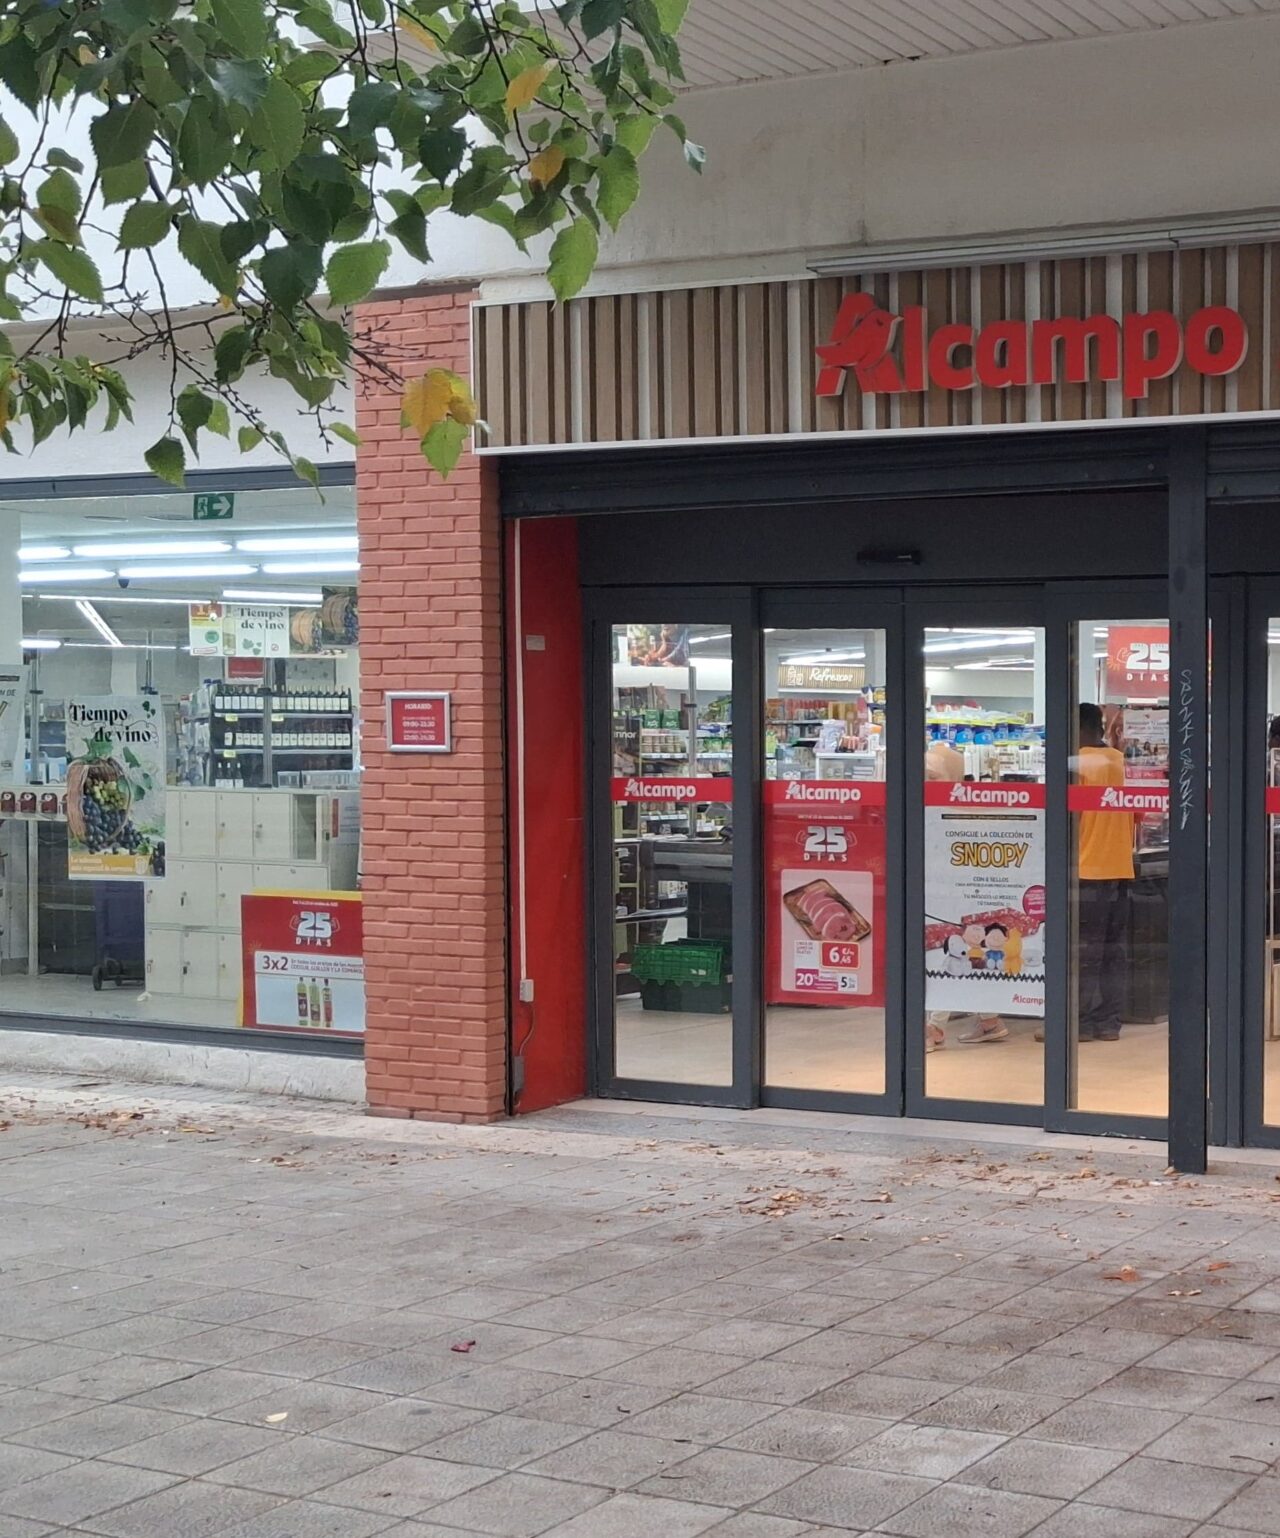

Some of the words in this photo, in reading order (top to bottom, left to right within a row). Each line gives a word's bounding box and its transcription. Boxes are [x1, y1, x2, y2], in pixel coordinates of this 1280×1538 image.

[815, 292, 1248, 399] Alcampo
[238, 607, 285, 620] Tiempo
[241, 620, 254, 629] de
[259, 620, 285, 630] vino
[1126, 643, 1169, 670] 25
[809, 667, 853, 682] Refrescos
[1127, 671, 1169, 682] DÍAS
[69, 704, 128, 723] Tiempo
[94, 728, 112, 743] de
[117, 727, 151, 743] vino
[624, 778, 697, 800] Alcampo
[785, 781, 861, 803] Alcampo
[949, 782, 1030, 806] Alcampo
[804, 826, 849, 853] 25
[989, 830, 1024, 839] COLECCIÓN
[950, 841, 1029, 868] SNOOPY
[297, 911, 333, 938] 25
[262, 955, 289, 971] 3x2
[829, 946, 840, 963] 6
[841, 976, 848, 988] 5
[1012, 994, 1045, 1005] Alcamp
